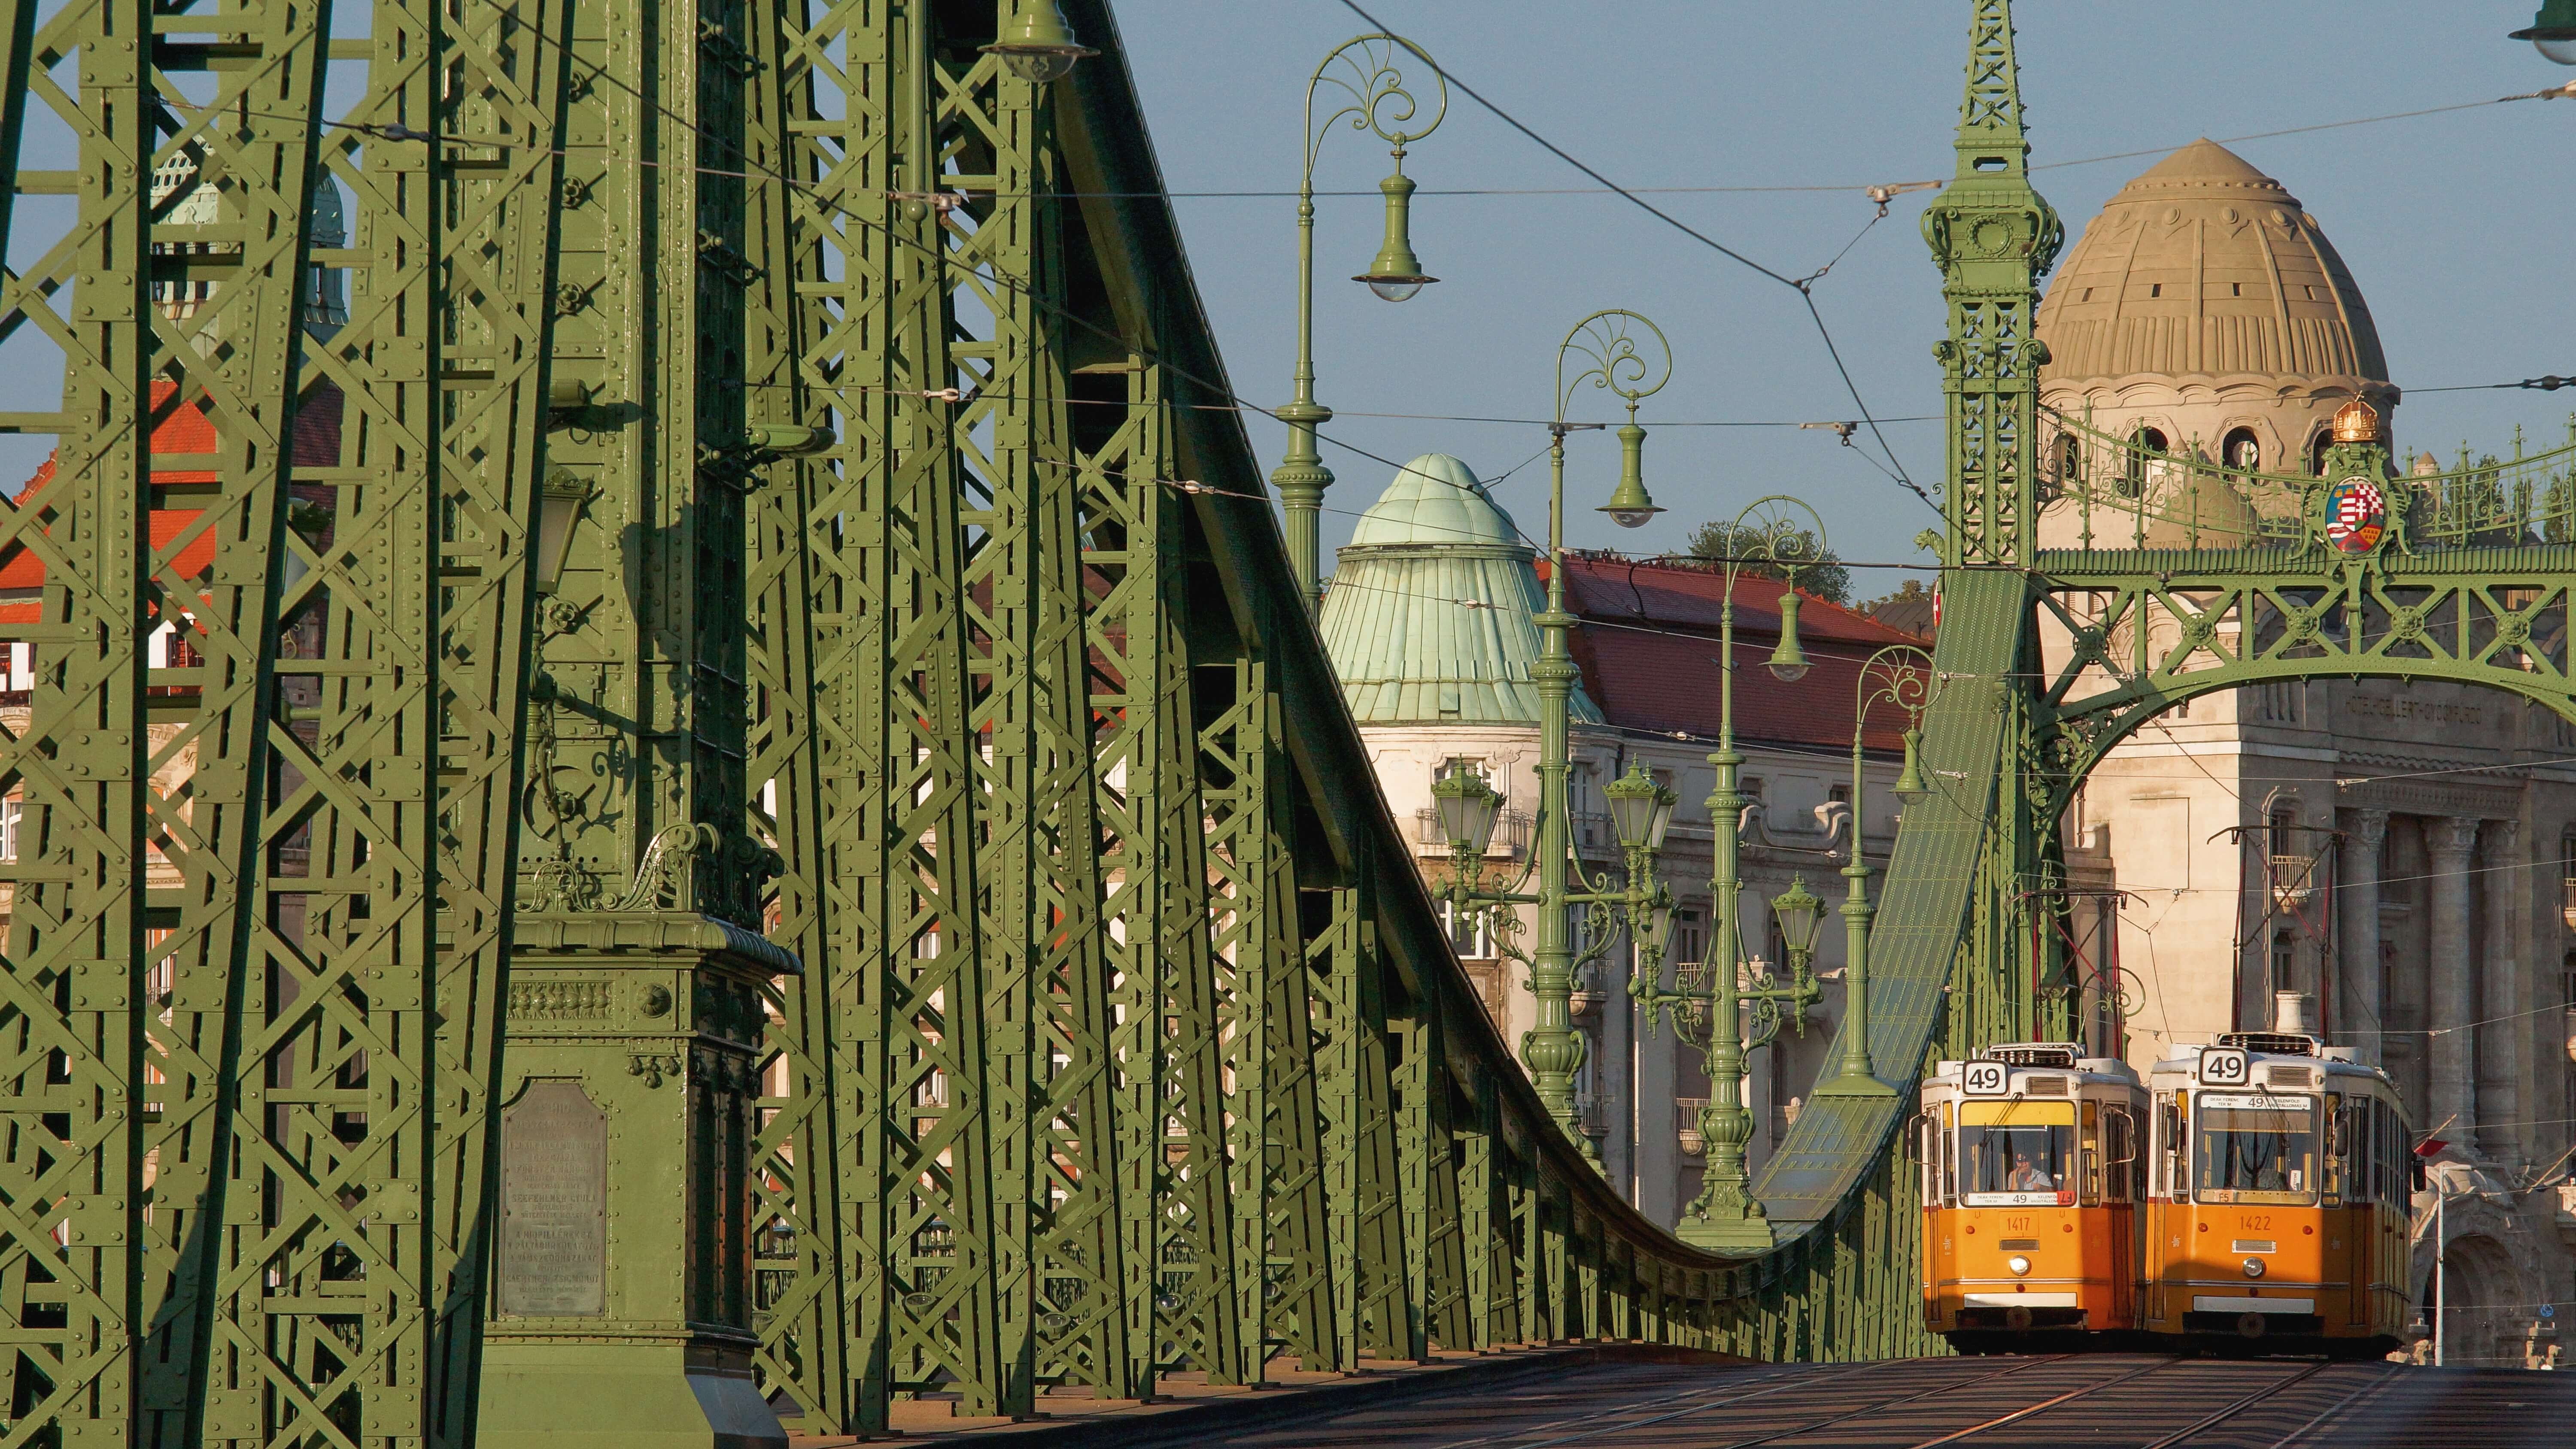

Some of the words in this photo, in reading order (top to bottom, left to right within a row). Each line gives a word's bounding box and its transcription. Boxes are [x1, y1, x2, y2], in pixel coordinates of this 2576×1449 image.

[2208, 1056, 2242, 1079] 49
[1968, 1068, 2000, 1089] 49
[2248, 1097, 2264, 1107] 49
[2013, 1194, 2027, 1203] 49
[2219, 1193, 2229, 1202] F5
[2007, 1217, 2030, 1231] 1417
[2240, 1216, 2271, 1231] 1422
